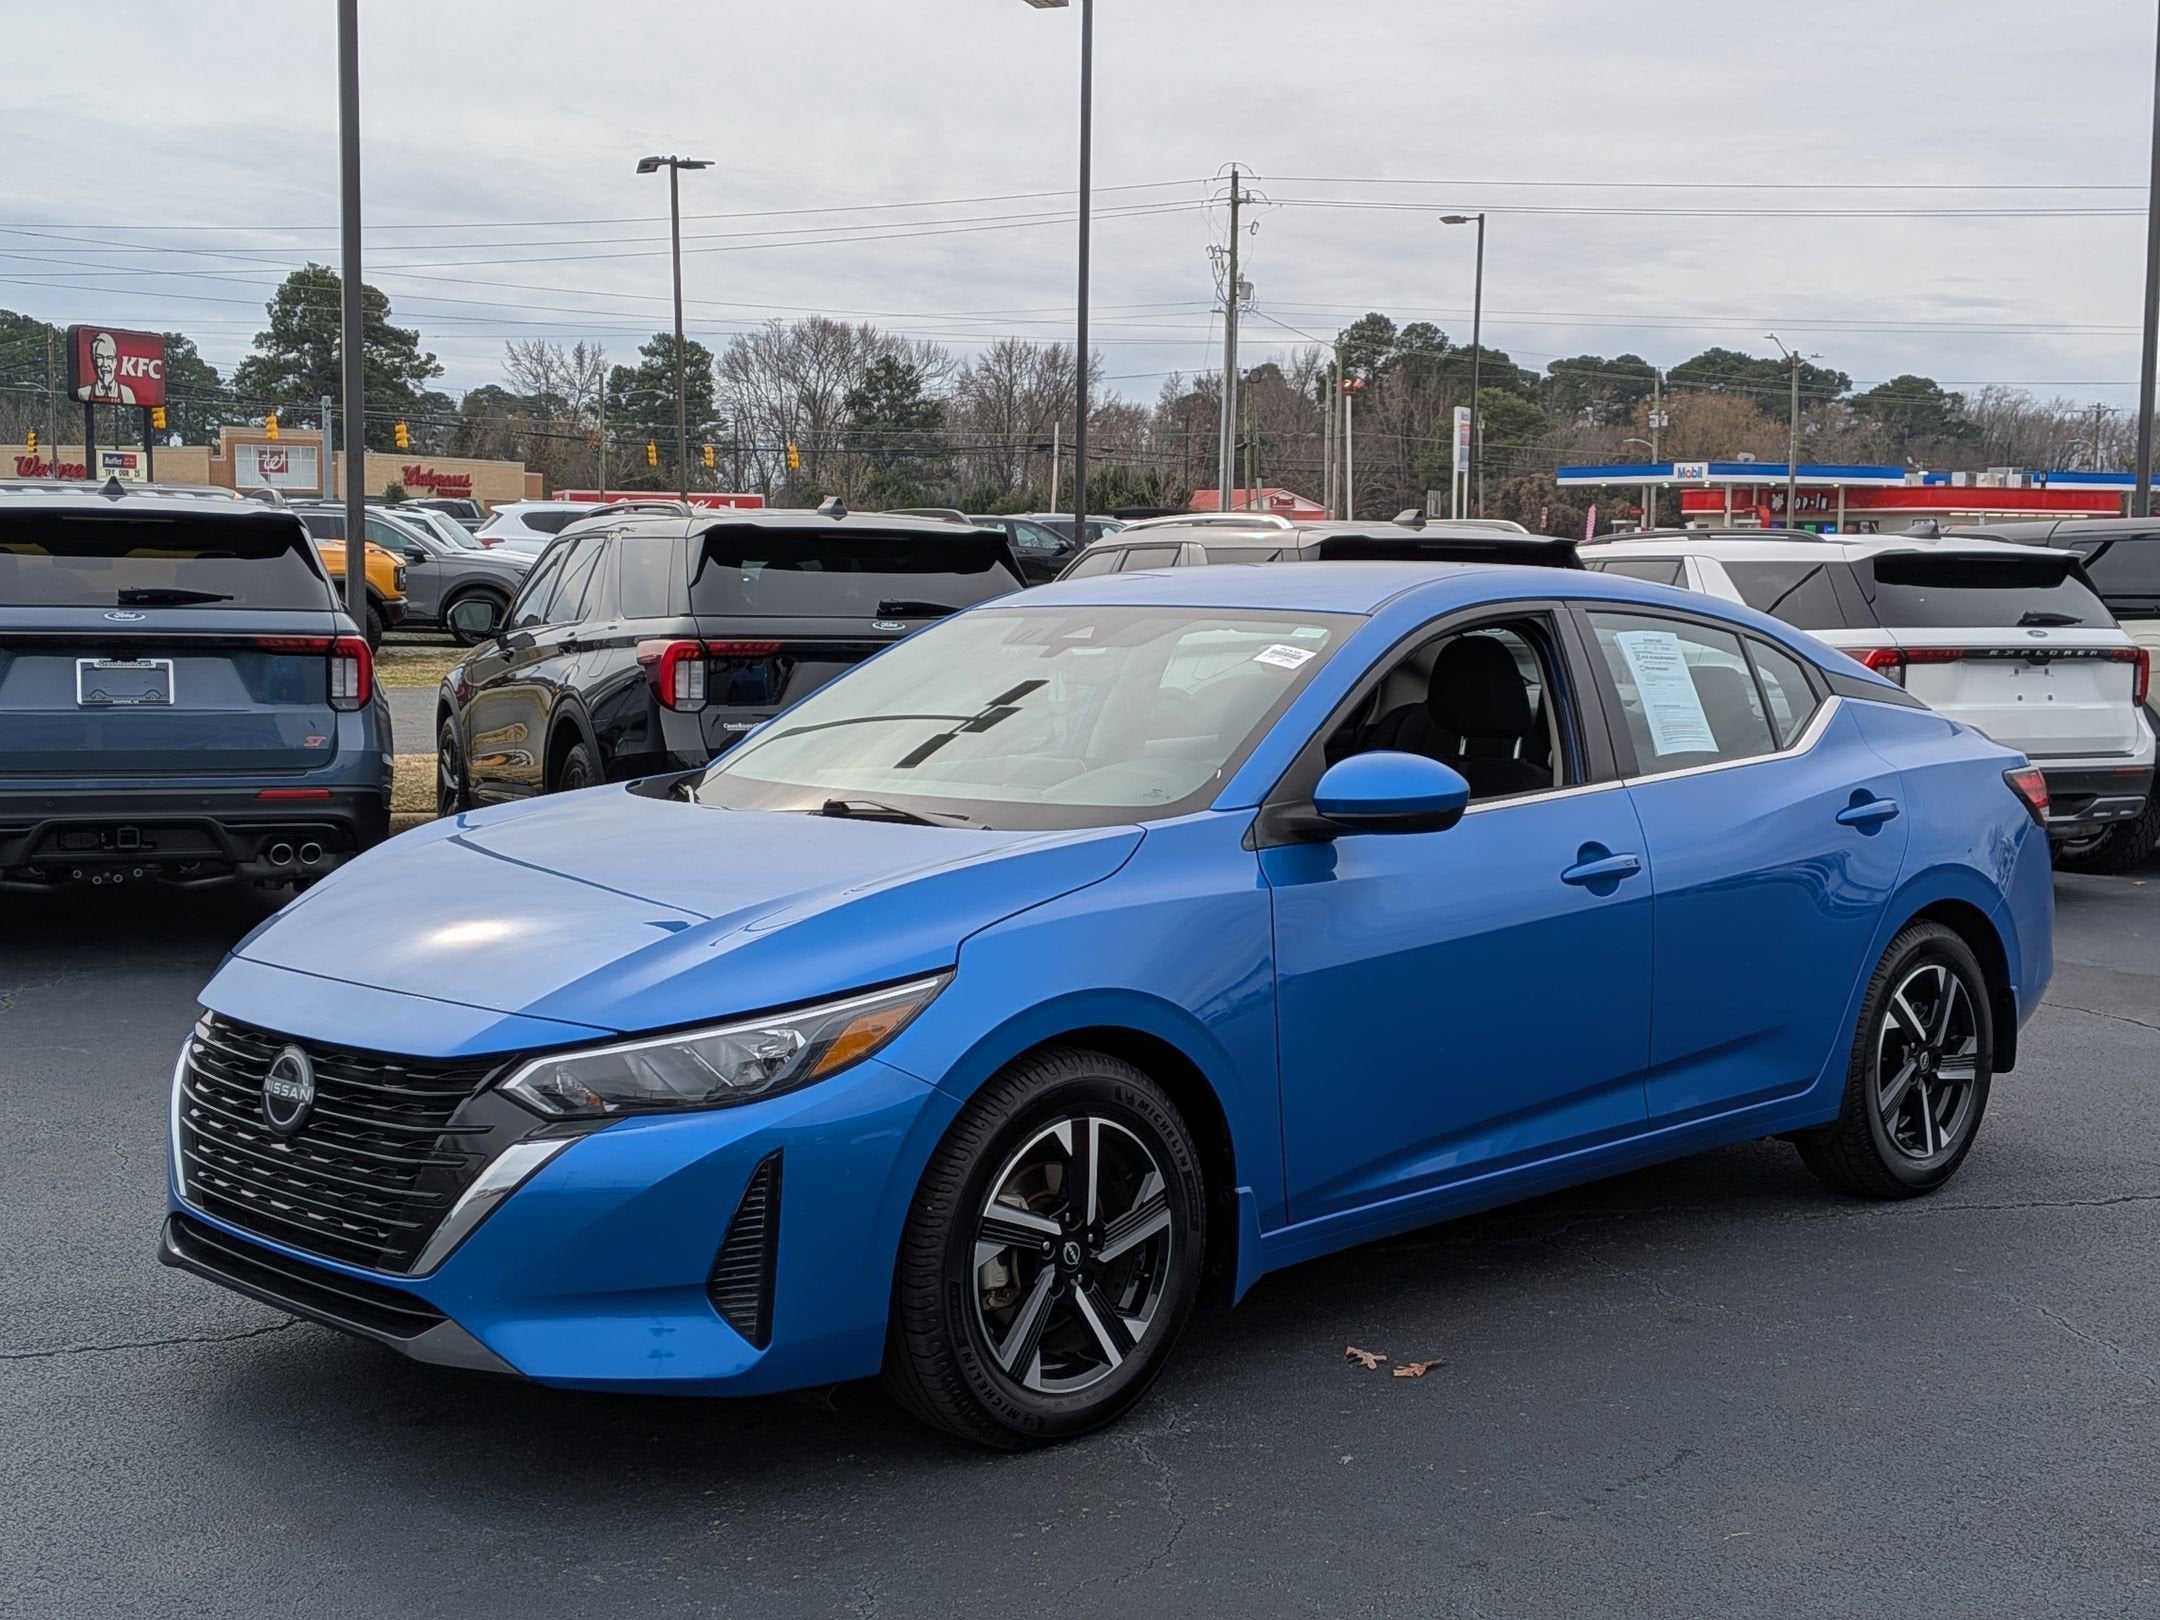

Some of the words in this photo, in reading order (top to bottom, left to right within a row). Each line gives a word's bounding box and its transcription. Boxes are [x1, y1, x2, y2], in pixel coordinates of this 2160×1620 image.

[120, 356, 162, 379] KFC
[1677, 466, 1703, 479] Mobil
[1989, 649, 2099, 657] EXPLORER
[265, 1077, 311, 1101] NISSAN
[1138, 1099, 1189, 1168] MICHELIN
[962, 1351, 1021, 1420] MICHELIN
